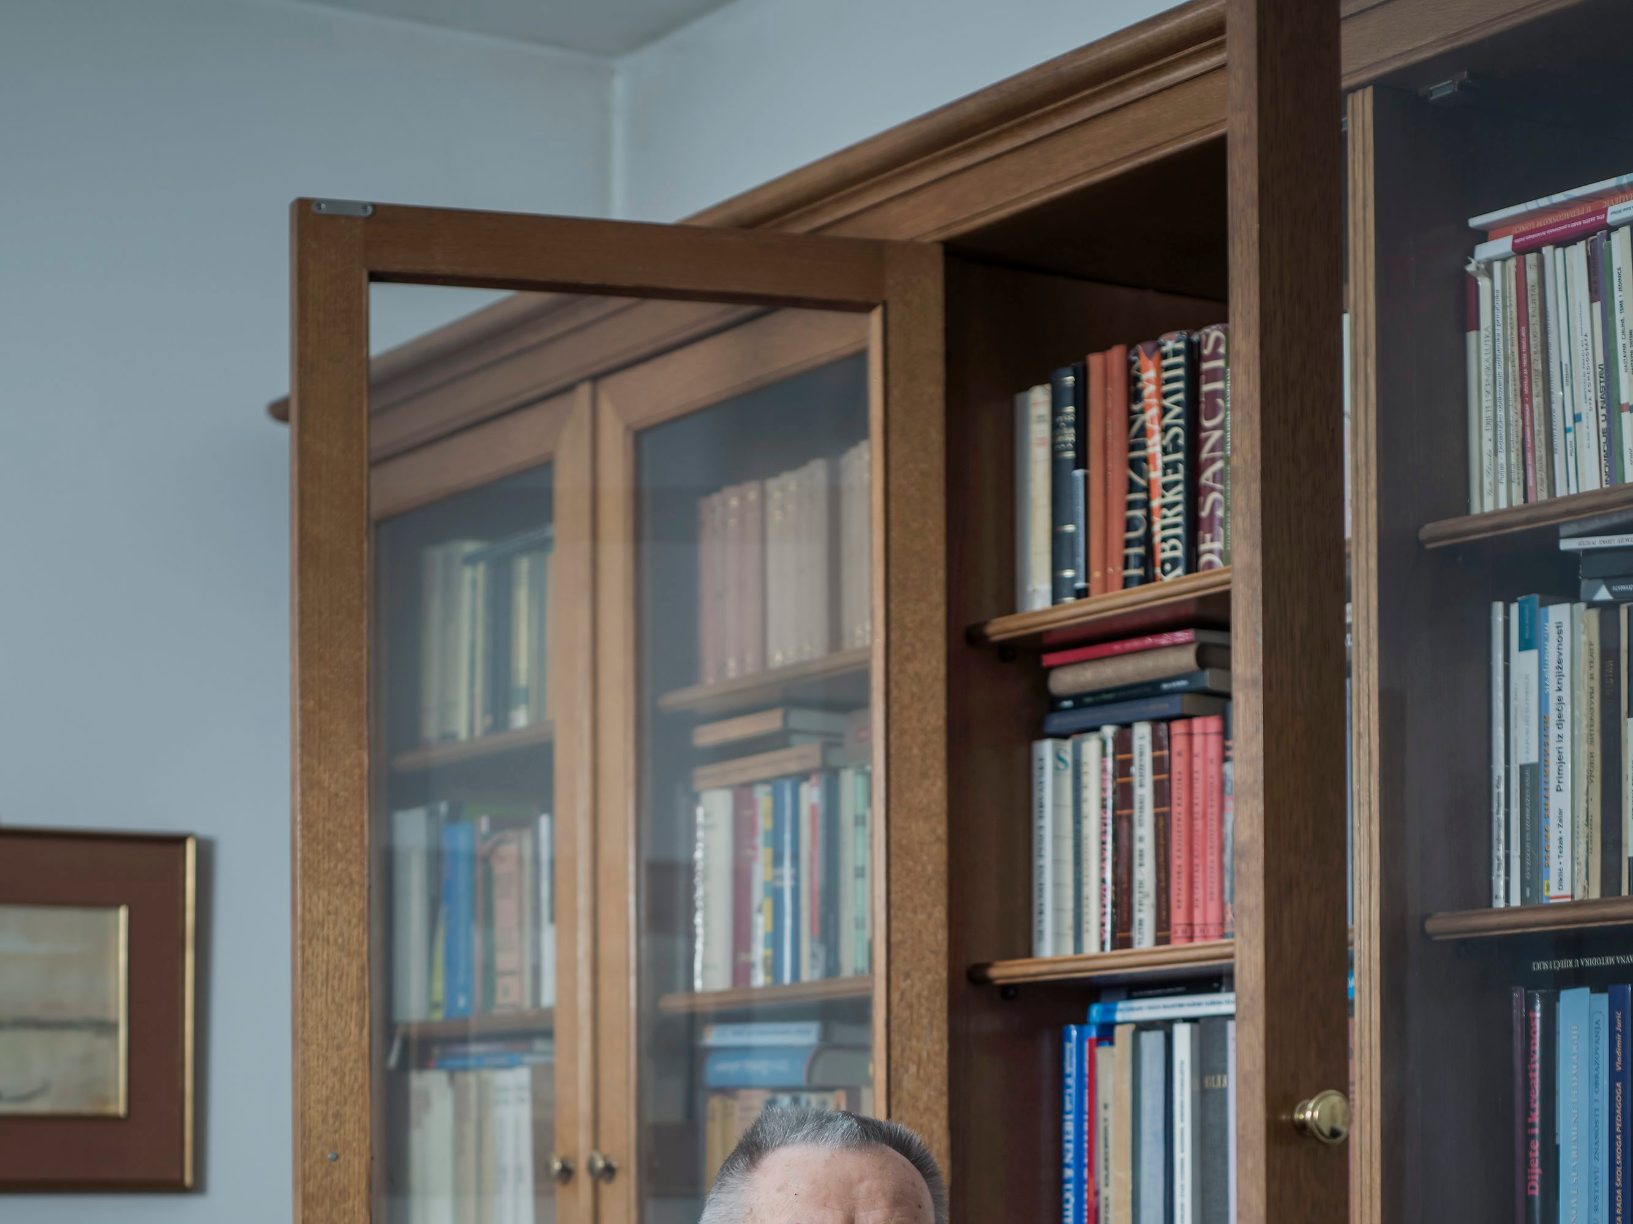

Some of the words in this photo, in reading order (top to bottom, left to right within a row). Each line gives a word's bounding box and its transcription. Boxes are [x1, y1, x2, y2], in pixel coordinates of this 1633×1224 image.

[1598, 363, 1607, 409] NASTAVI
[1199, 329, 1225, 518] SANCTIS
[1199, 526, 1224, 570] DE
[1554, 621, 1565, 692] književnosti
[1555, 695, 1566, 730] dječje
[1556, 733, 1564, 743] iz
[1555, 746, 1566, 792] Primjeri
[1580, 956, 1616, 968] METODIKA
[1527, 1009, 1540, 1124] kreativnost
[1592, 1019, 1601, 1095] OBRAZOVANJA
[1615, 1082, 1623, 1133] PEDAGOGA
[1527, 1140, 1542, 1197] Dijete
[1613, 1135, 1623, 1187] ŠKOLSKOGA
[1615, 1189, 1623, 1215] RADA
